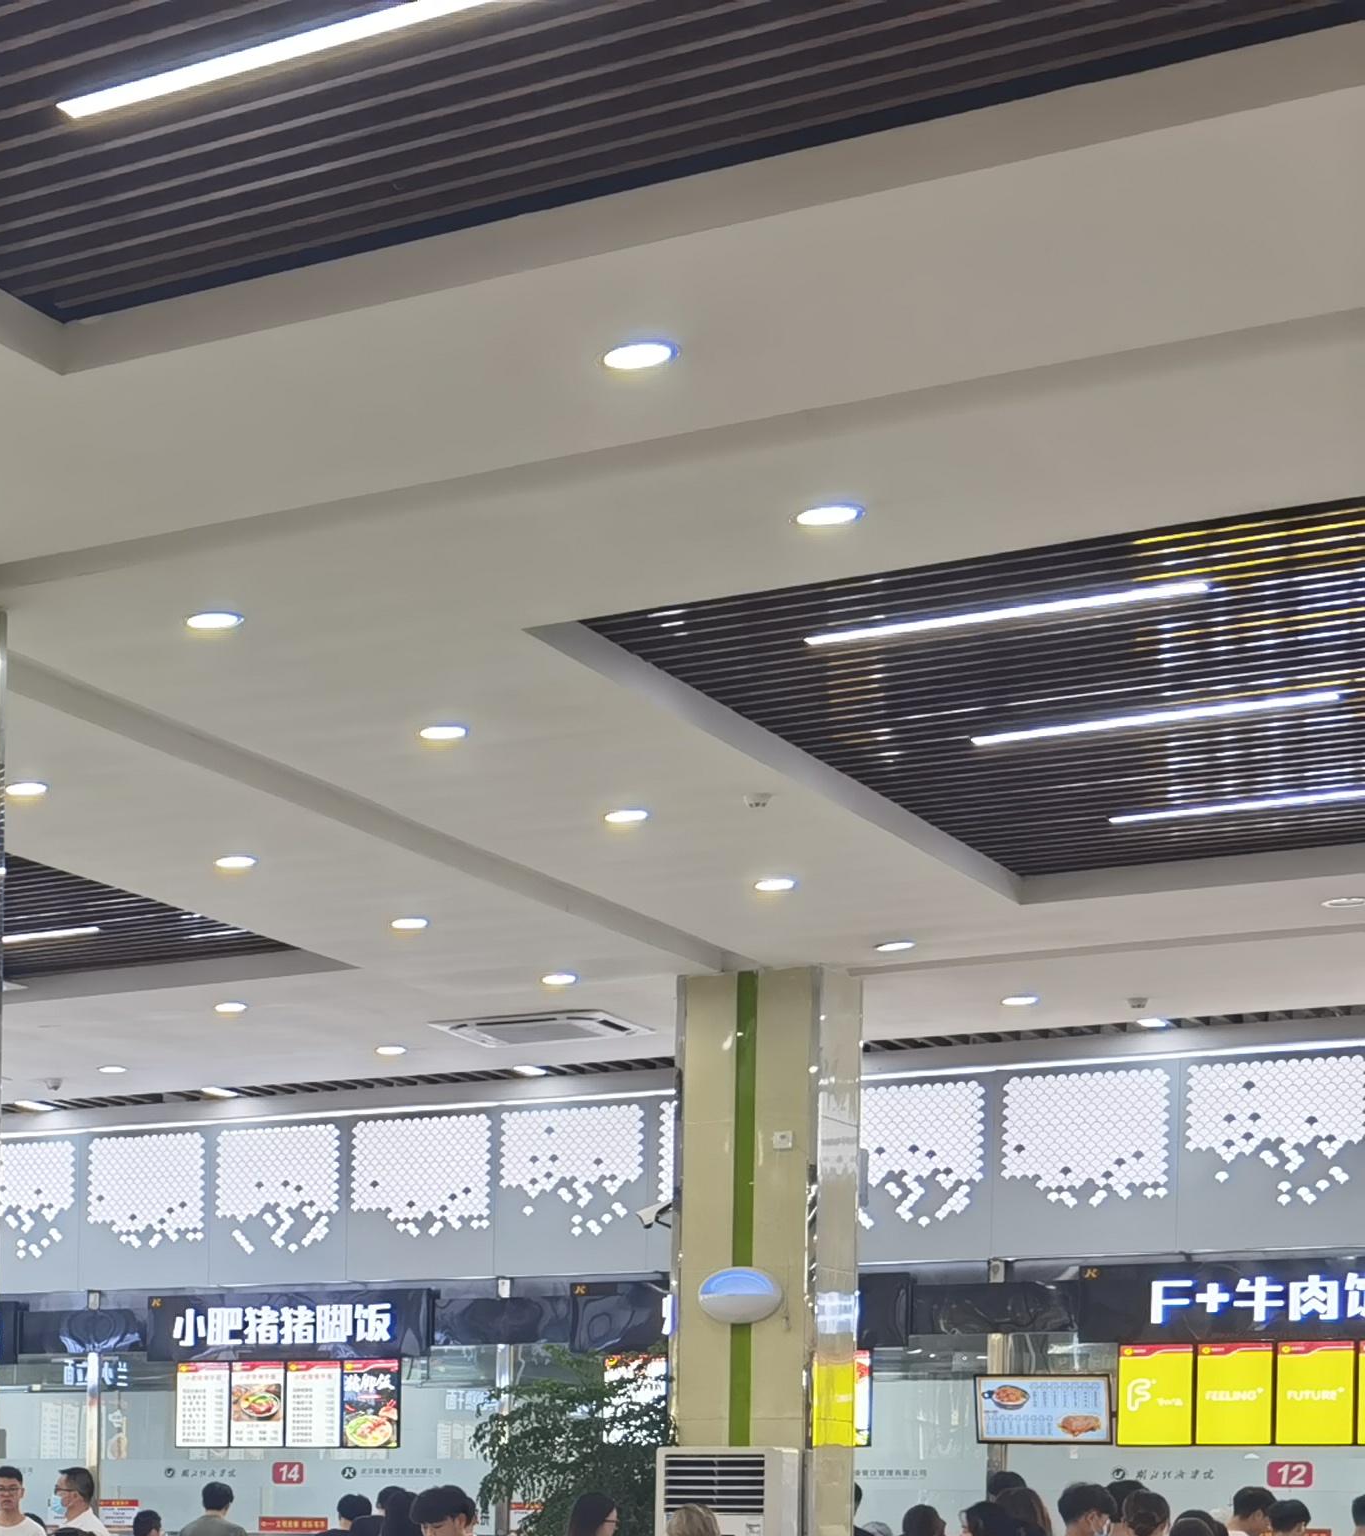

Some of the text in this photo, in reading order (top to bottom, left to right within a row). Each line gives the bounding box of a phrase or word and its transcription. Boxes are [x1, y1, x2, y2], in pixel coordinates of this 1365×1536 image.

[173, 1302, 391, 1347] 小肥猪猪脚饭
[279, 1464, 301, 1482] 14
[1277, 1463, 1308, 1486] 12
